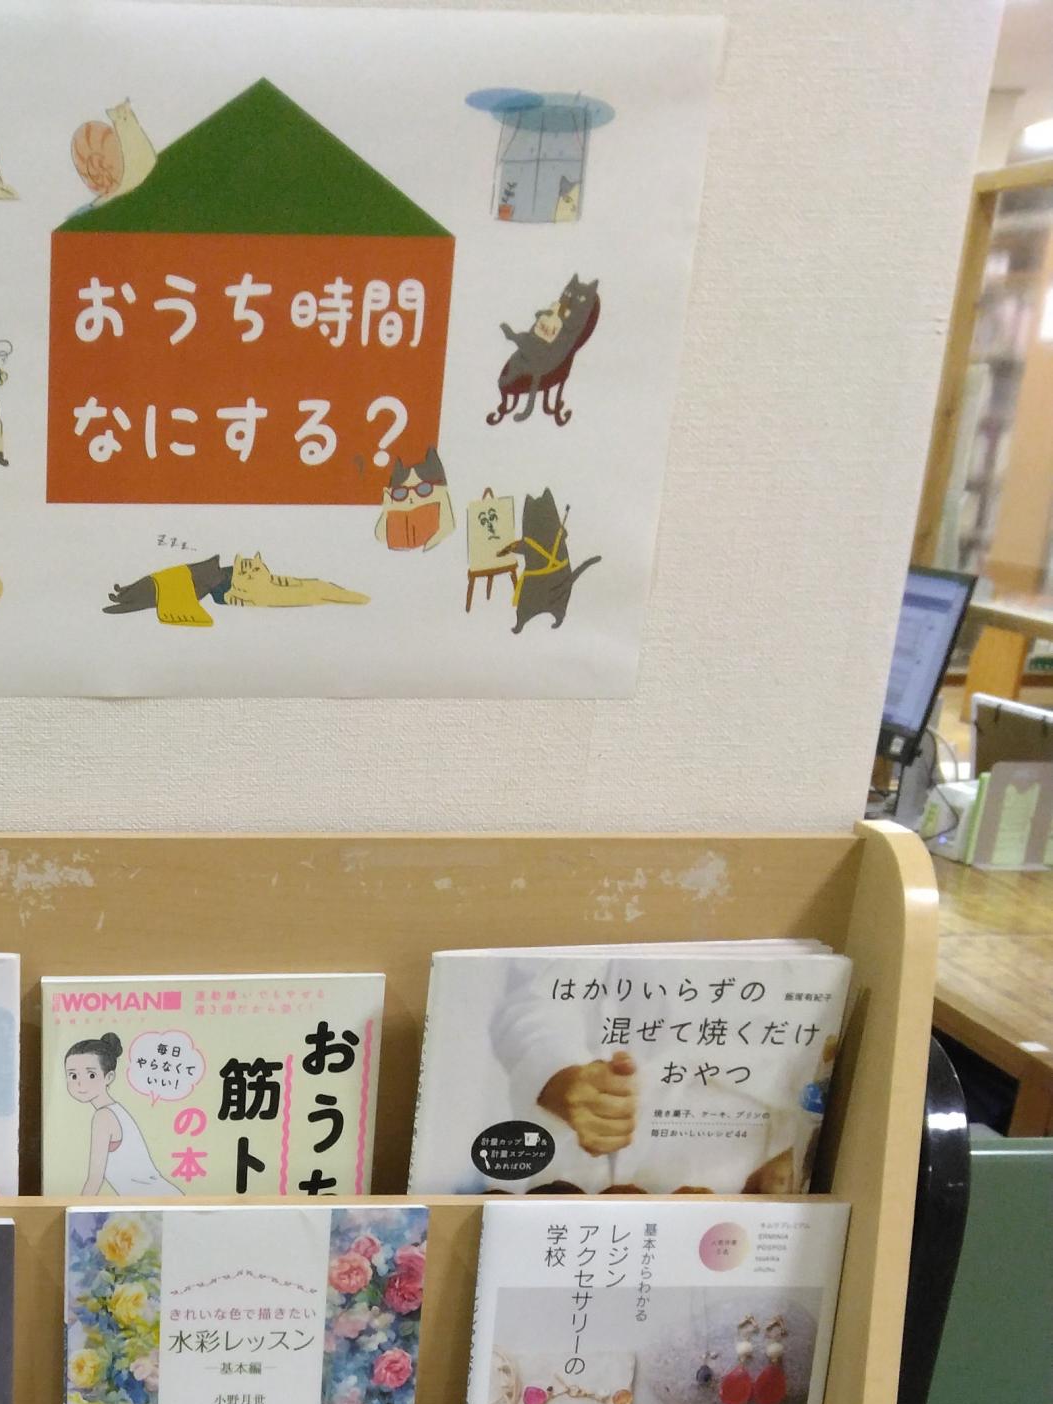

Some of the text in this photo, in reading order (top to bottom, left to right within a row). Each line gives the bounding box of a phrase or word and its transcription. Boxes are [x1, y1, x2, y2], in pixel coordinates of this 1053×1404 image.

[75, 273, 424, 346] おうち時間
[72, 396, 408, 468] なにする?
[61, 991, 162, 1012] WOMAN
[551, 978, 766, 1002] はかりいらずの
[600, 1016, 821, 1046] 混ぜて焼くだけ
[137, 1057, 196, 1077] やらなくて
[157, 1043, 181, 1057] 毎日
[660, 1061, 751, 1086] おやつ
[217, 1057, 284, 1193] 筋ト
[171, 1107, 208, 1182] の本
[544, 1224, 568, 1267] 学校
[606, 1224, 631, 1288] レジン
[634, 1222, 658, 1323] 基本からわかる
[169, 1306, 317, 1322] きれいな色で描きたい
[564, 1225, 600, 1376] アクセサリーの
[168, 1329, 316, 1354] 水彩レッスン
